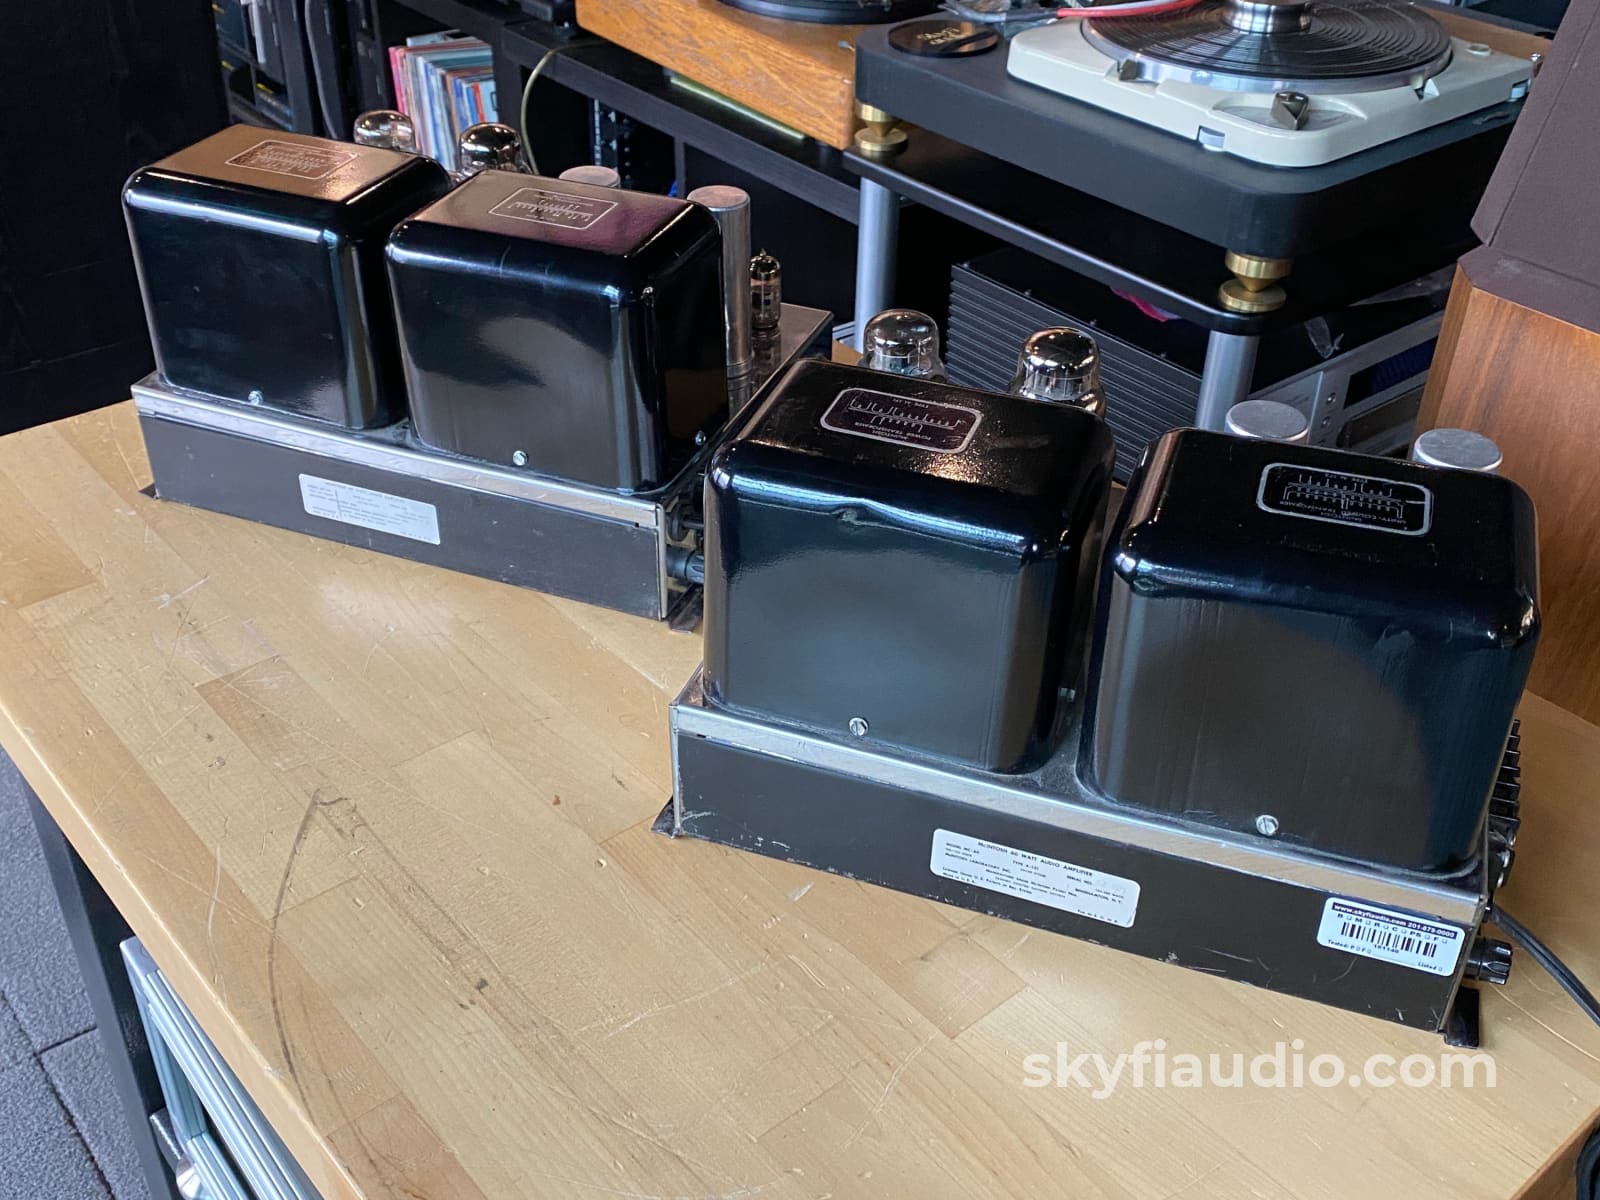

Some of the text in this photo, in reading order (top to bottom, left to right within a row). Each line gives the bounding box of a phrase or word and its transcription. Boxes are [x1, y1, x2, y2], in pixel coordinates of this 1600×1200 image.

[1021, 853, 1038, 862] WATT
[1040, 858, 1060, 868] AUDIO
[1063, 865, 1093, 877] AMPLIFIER
